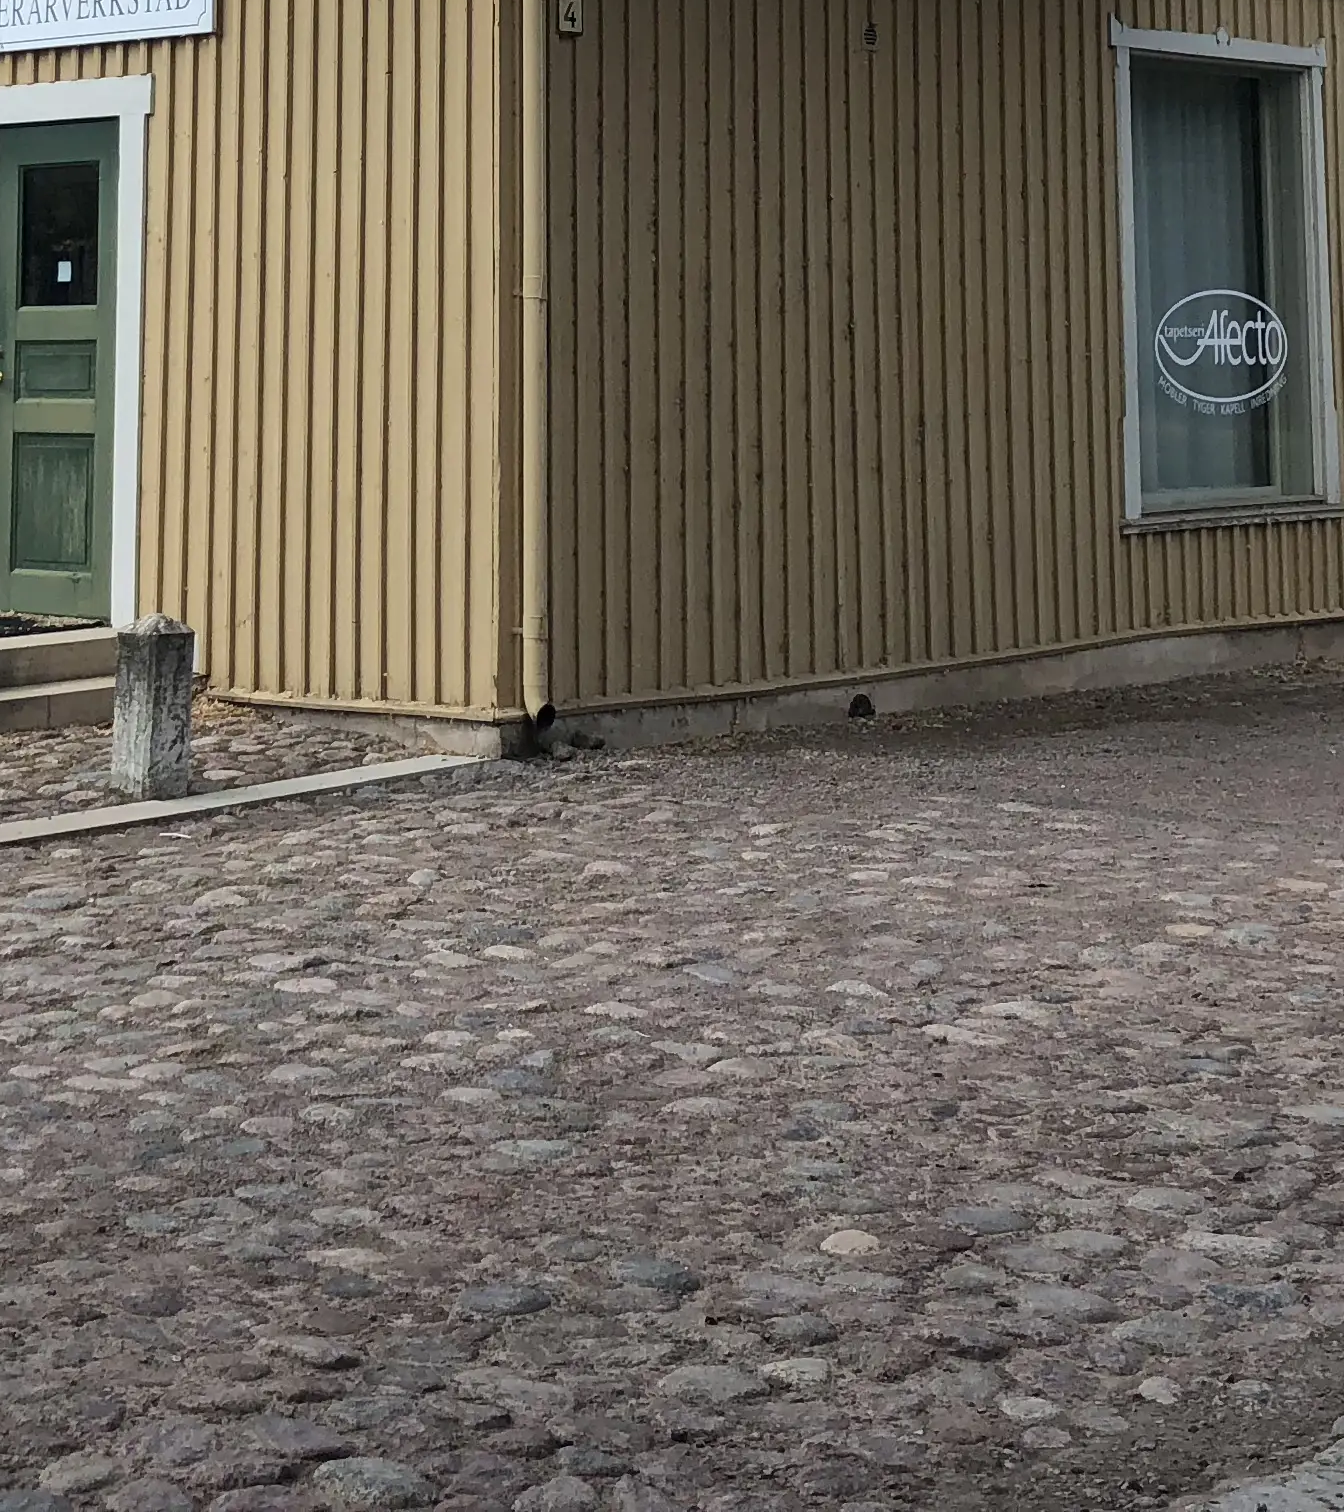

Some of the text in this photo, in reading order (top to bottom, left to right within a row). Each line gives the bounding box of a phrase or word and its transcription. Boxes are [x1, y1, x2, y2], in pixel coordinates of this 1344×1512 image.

[563, 1, 577, 28] 4
[1164, 322, 1206, 344] tapetseri
[1192, 399, 1217, 415] TYGER
[1220, 402, 1246, 416] KAPELL
